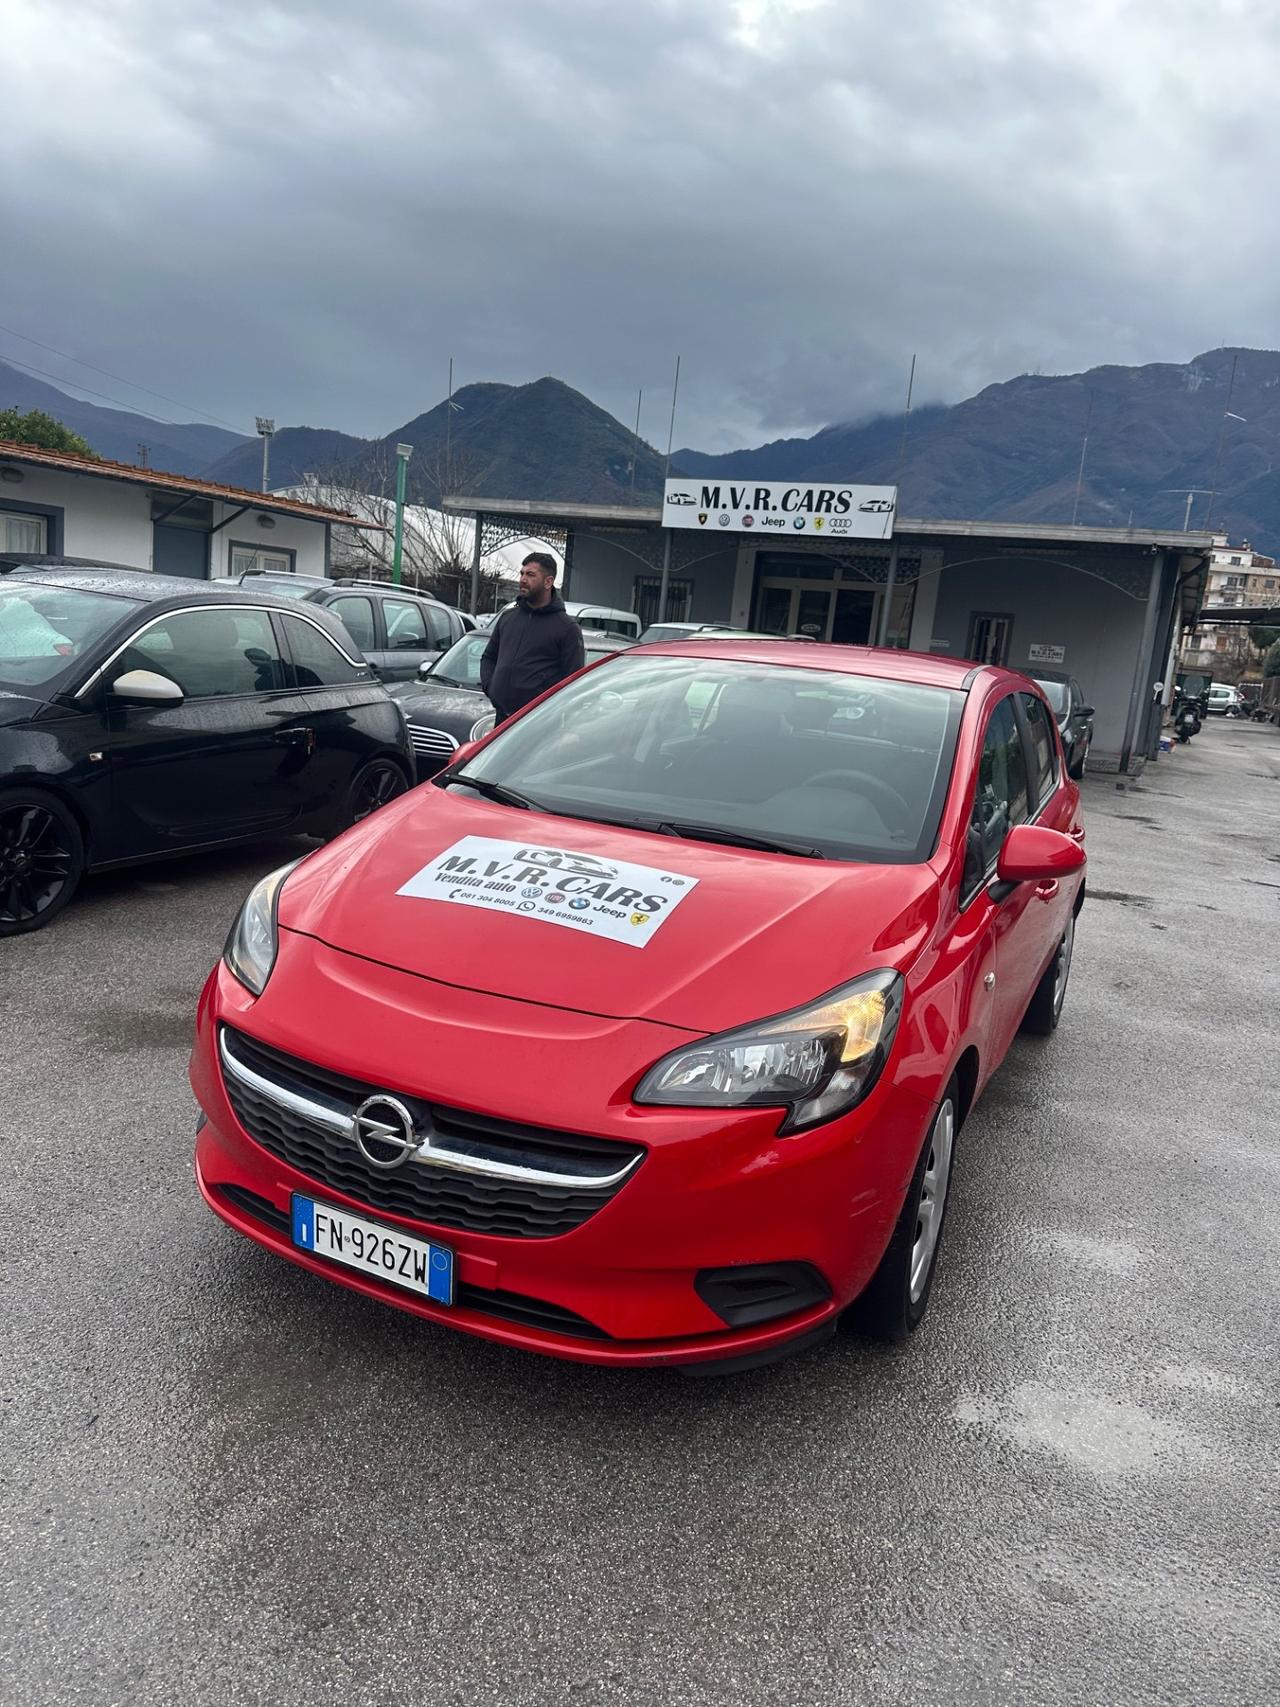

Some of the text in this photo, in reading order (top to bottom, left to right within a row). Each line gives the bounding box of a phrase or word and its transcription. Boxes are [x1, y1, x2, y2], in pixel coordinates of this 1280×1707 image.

[700, 486, 852, 513] M.V.R.CARS
[762, 516, 786, 528] Jeep
[436, 872, 517, 893] Vendita auto
[437, 856, 668, 913] M.V.R.CARS
[537, 907, 555, 916] 349
[593, 904, 627, 919] Jeep
